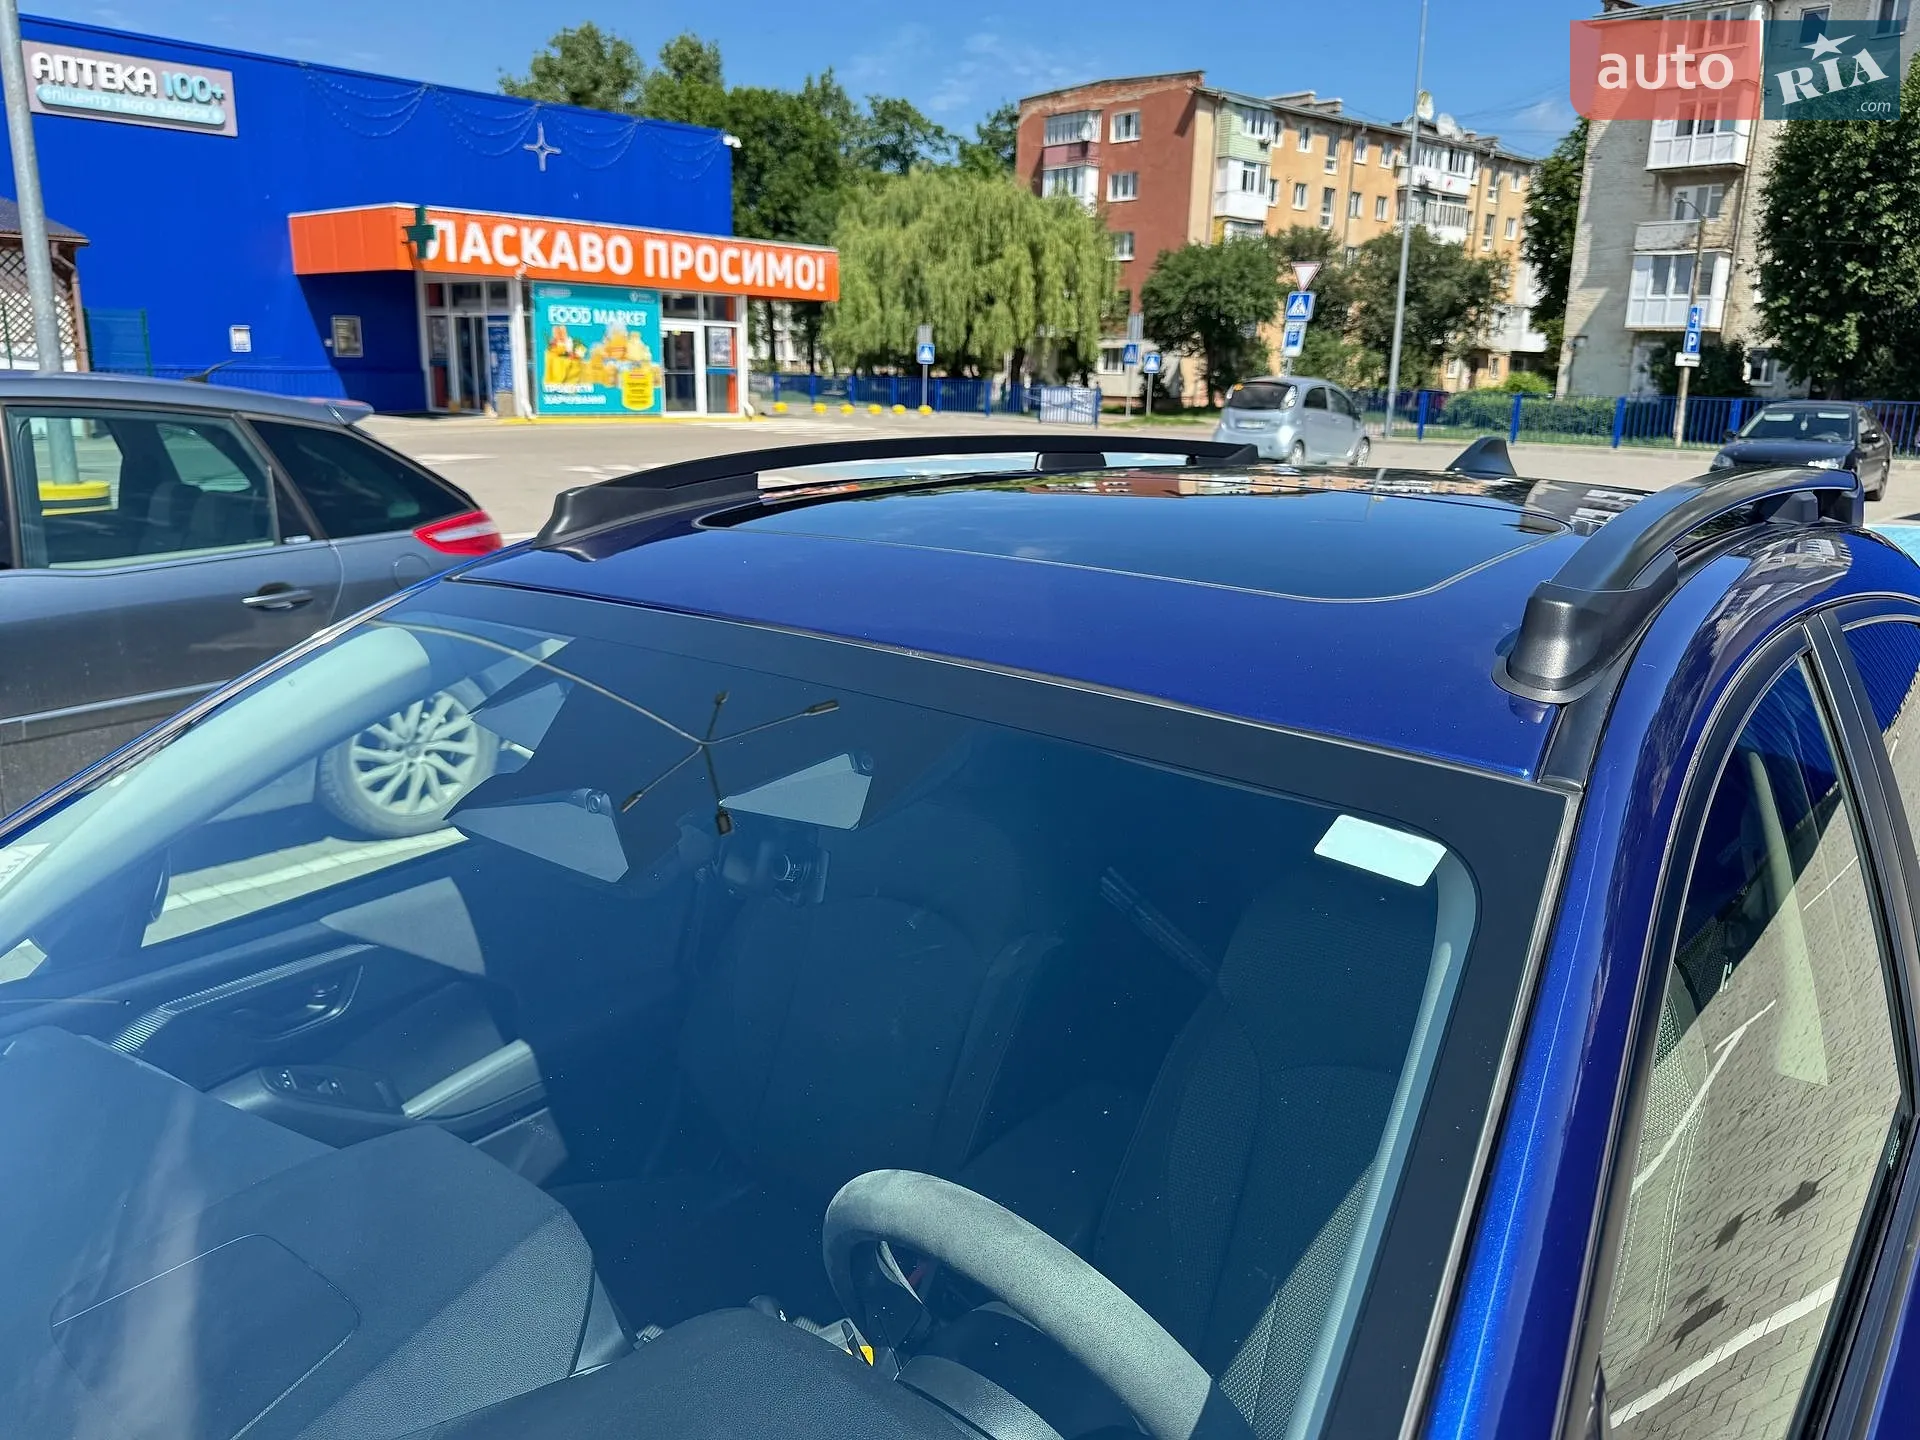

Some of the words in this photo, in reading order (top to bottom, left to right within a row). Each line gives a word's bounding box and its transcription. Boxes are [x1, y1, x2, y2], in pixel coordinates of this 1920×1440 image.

[31, 52, 157, 95] АПТЕКА
[163, 71, 225, 101] 100+
[427, 218, 634, 276] ЛАСКАВО
[643, 239, 826, 292] ПРОСИМО!
[548, 305, 592, 325] FOOD
[592, 308, 647, 327] MARKET
